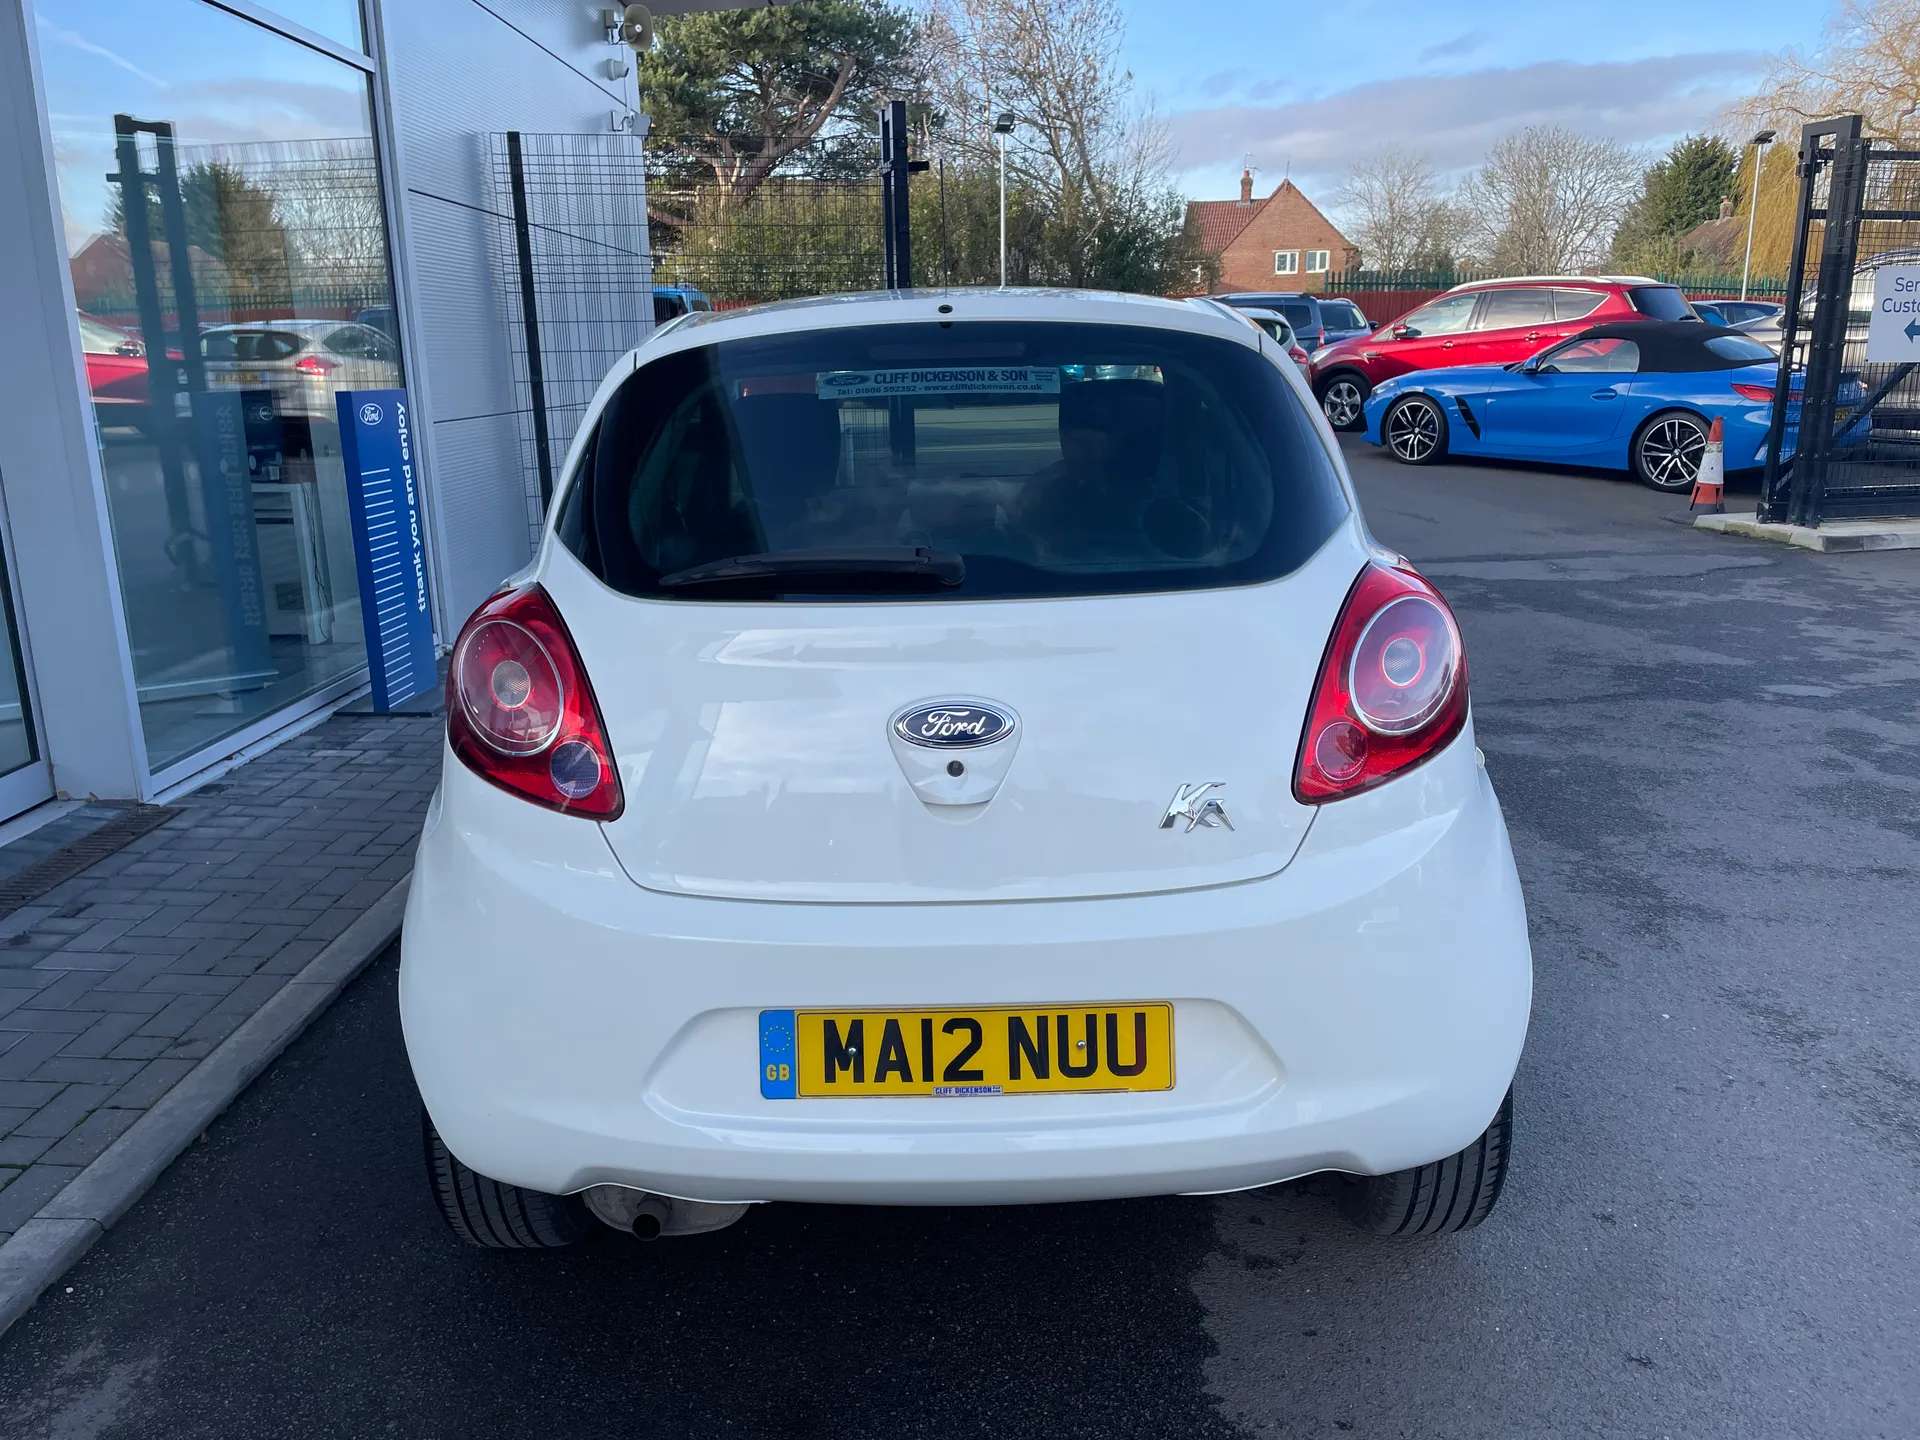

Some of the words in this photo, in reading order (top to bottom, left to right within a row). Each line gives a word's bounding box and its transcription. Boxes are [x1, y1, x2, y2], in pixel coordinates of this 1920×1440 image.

[874, 372, 909, 384] CLIFF
[911, 370, 985, 382] DICKENSON
[987, 370, 999, 381] &
[1001, 369, 1028, 381] SON
[396, 402, 409, 461] enjoy
[402, 464, 415, 506] and
[409, 509, 420, 548] you
[413, 551, 426, 612] thank
[921, 710, 986, 737] Ford
[823, 1018, 984, 1083] MA12
[1007, 1012, 1148, 1081] NUU
[766, 1064, 790, 1081] GB
